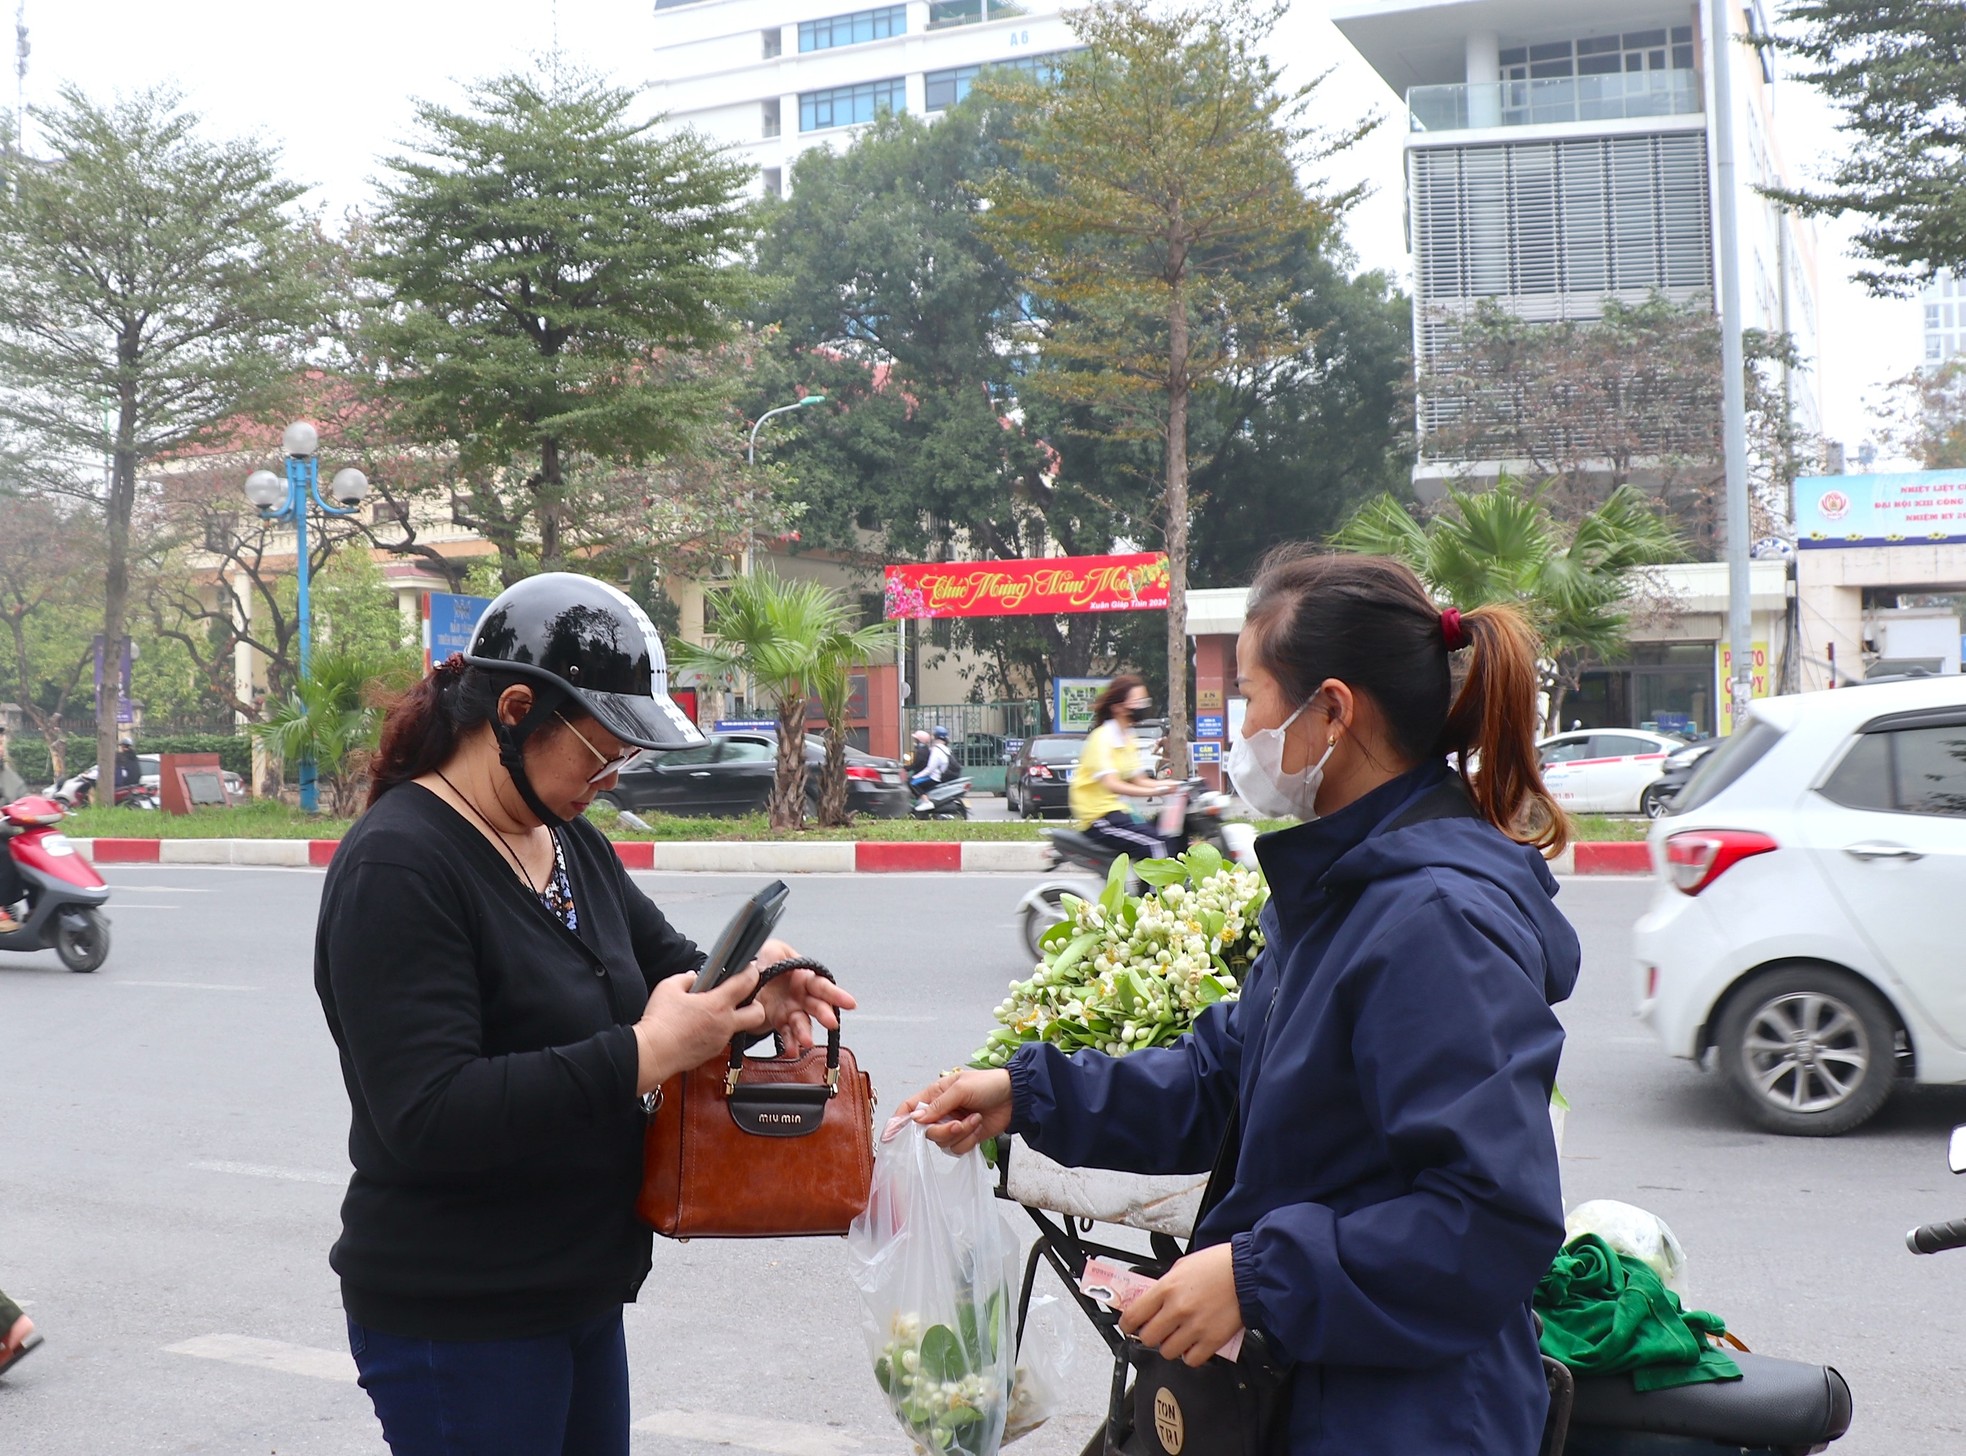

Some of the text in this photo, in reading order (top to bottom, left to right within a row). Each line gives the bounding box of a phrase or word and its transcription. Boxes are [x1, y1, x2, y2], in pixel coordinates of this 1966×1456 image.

[919, 573, 970, 608] Chúc
[958, 570, 1034, 609] Mừng
[1033, 568, 1090, 597] Năm
[1089, 602, 1109, 610] Xuân
[1111, 600, 1130, 610] Giáp
[1149, 598, 1168, 607] 2024
[1723, 649, 1765, 669] PTO
[1724, 675, 1765, 695] CPY
[1157, 1399, 1176, 1420] TON
[1159, 1424, 1178, 1446] TRI
